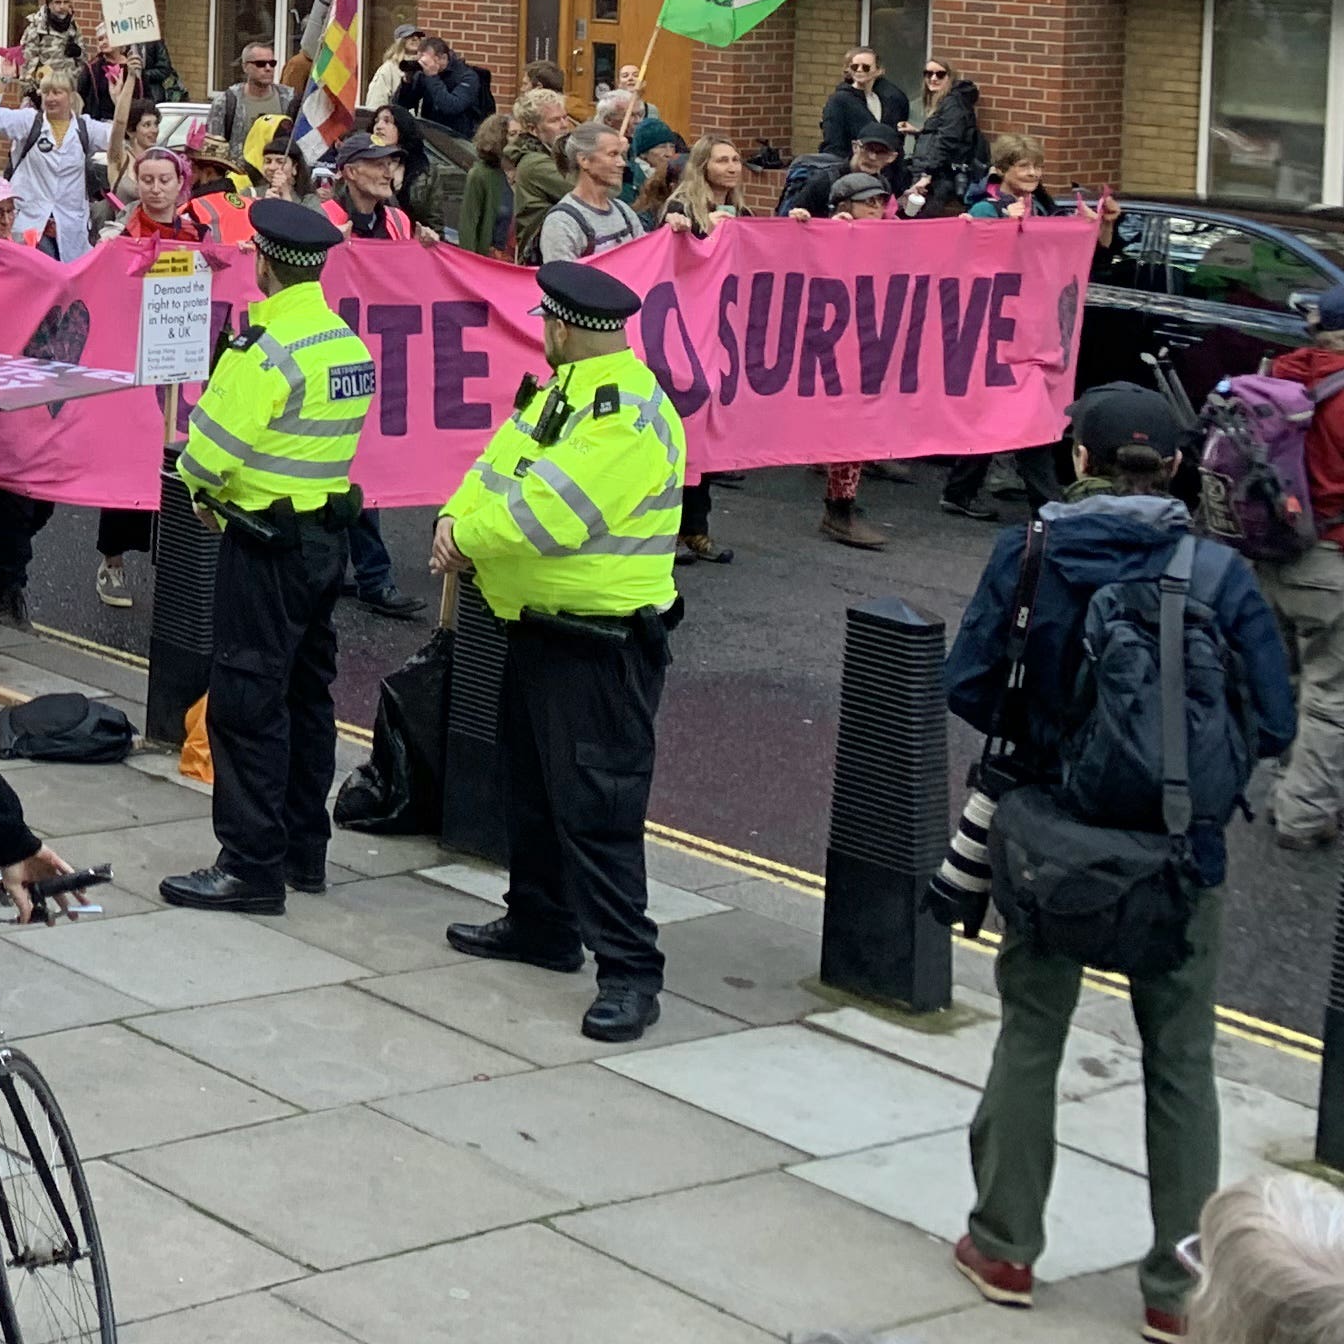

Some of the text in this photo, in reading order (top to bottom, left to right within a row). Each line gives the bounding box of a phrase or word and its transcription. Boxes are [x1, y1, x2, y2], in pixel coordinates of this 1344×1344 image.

[110, 14, 155, 34] MOTHER
[153, 280, 204, 297] Demand the
[148, 297, 209, 313] right to protest
[149, 312, 207, 326] in Hong Kong
[168, 327, 191, 339] & UK
[717, 272, 1022, 407] SURVIVE
[330, 372, 375, 399] POLICE
